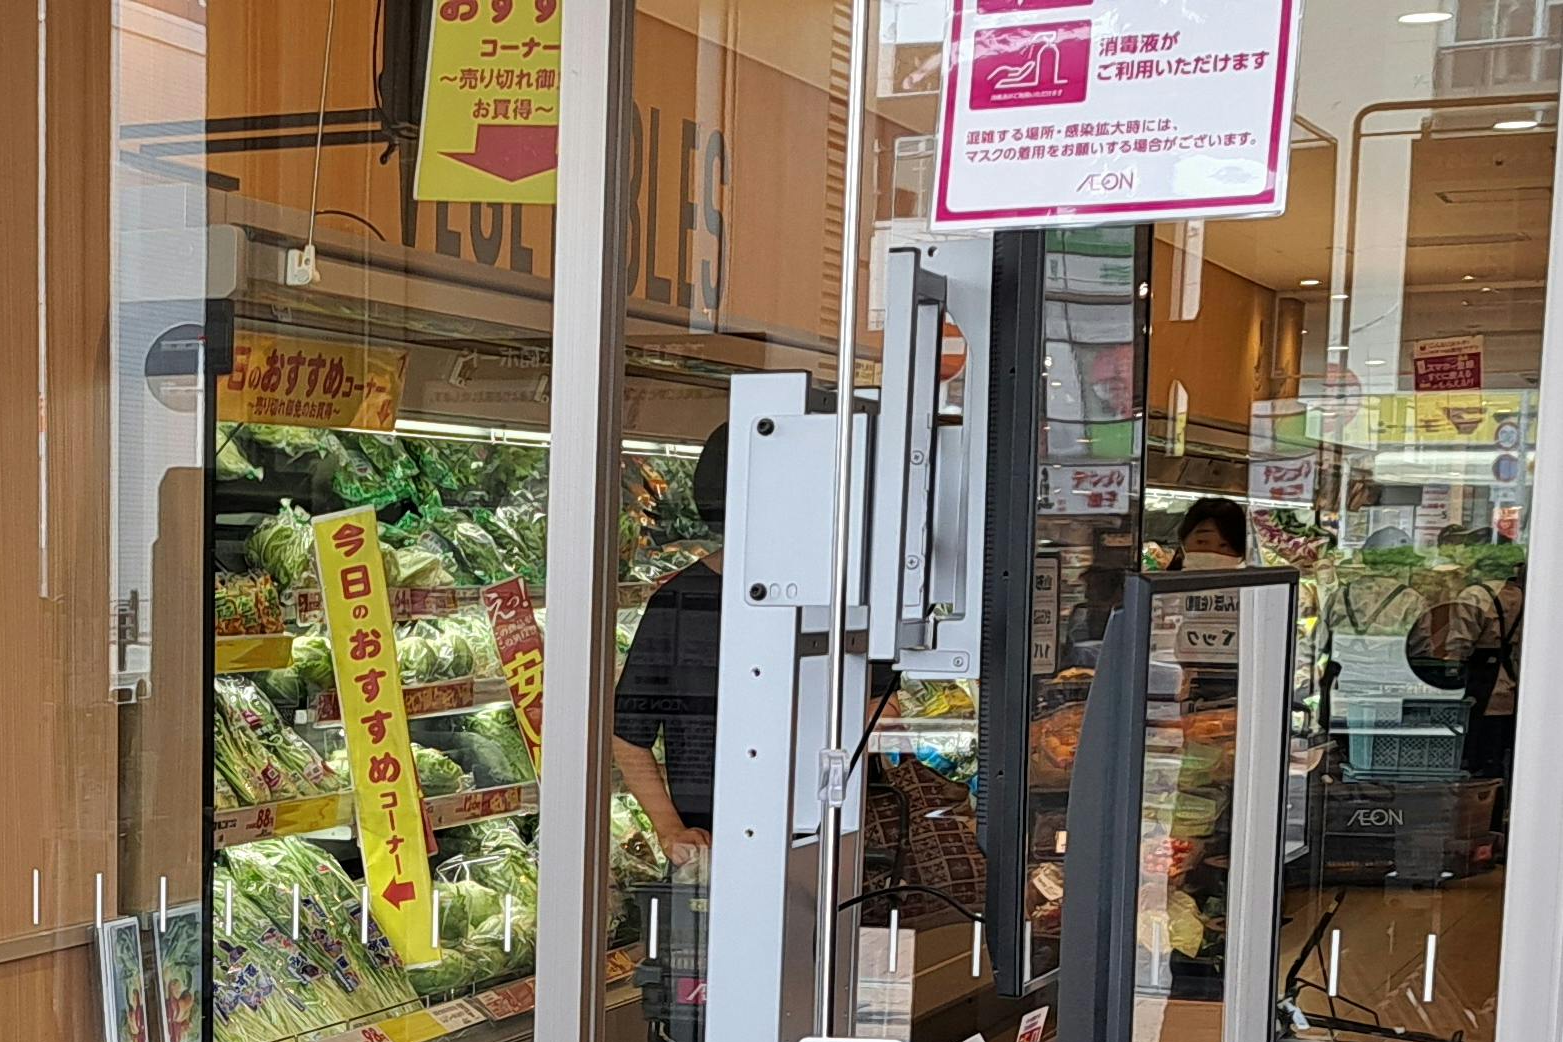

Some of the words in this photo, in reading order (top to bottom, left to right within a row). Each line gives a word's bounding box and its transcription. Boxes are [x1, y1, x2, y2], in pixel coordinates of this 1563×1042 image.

[480, 37, 561, 58] コーナー
[1098, 30, 1181, 57] 消毒液が
[440, 68, 561, 90] ～売り切れ御
[1096, 51, 1270, 82] ご利用いただけます
[966, 118, 1180, 146] 混雑する場所・感染拡大時には、
[965, 131, 1257, 163] マスクの着用をお願いする場合がございます。
[331, 522, 403, 876] 今日のおすすめコーナー
